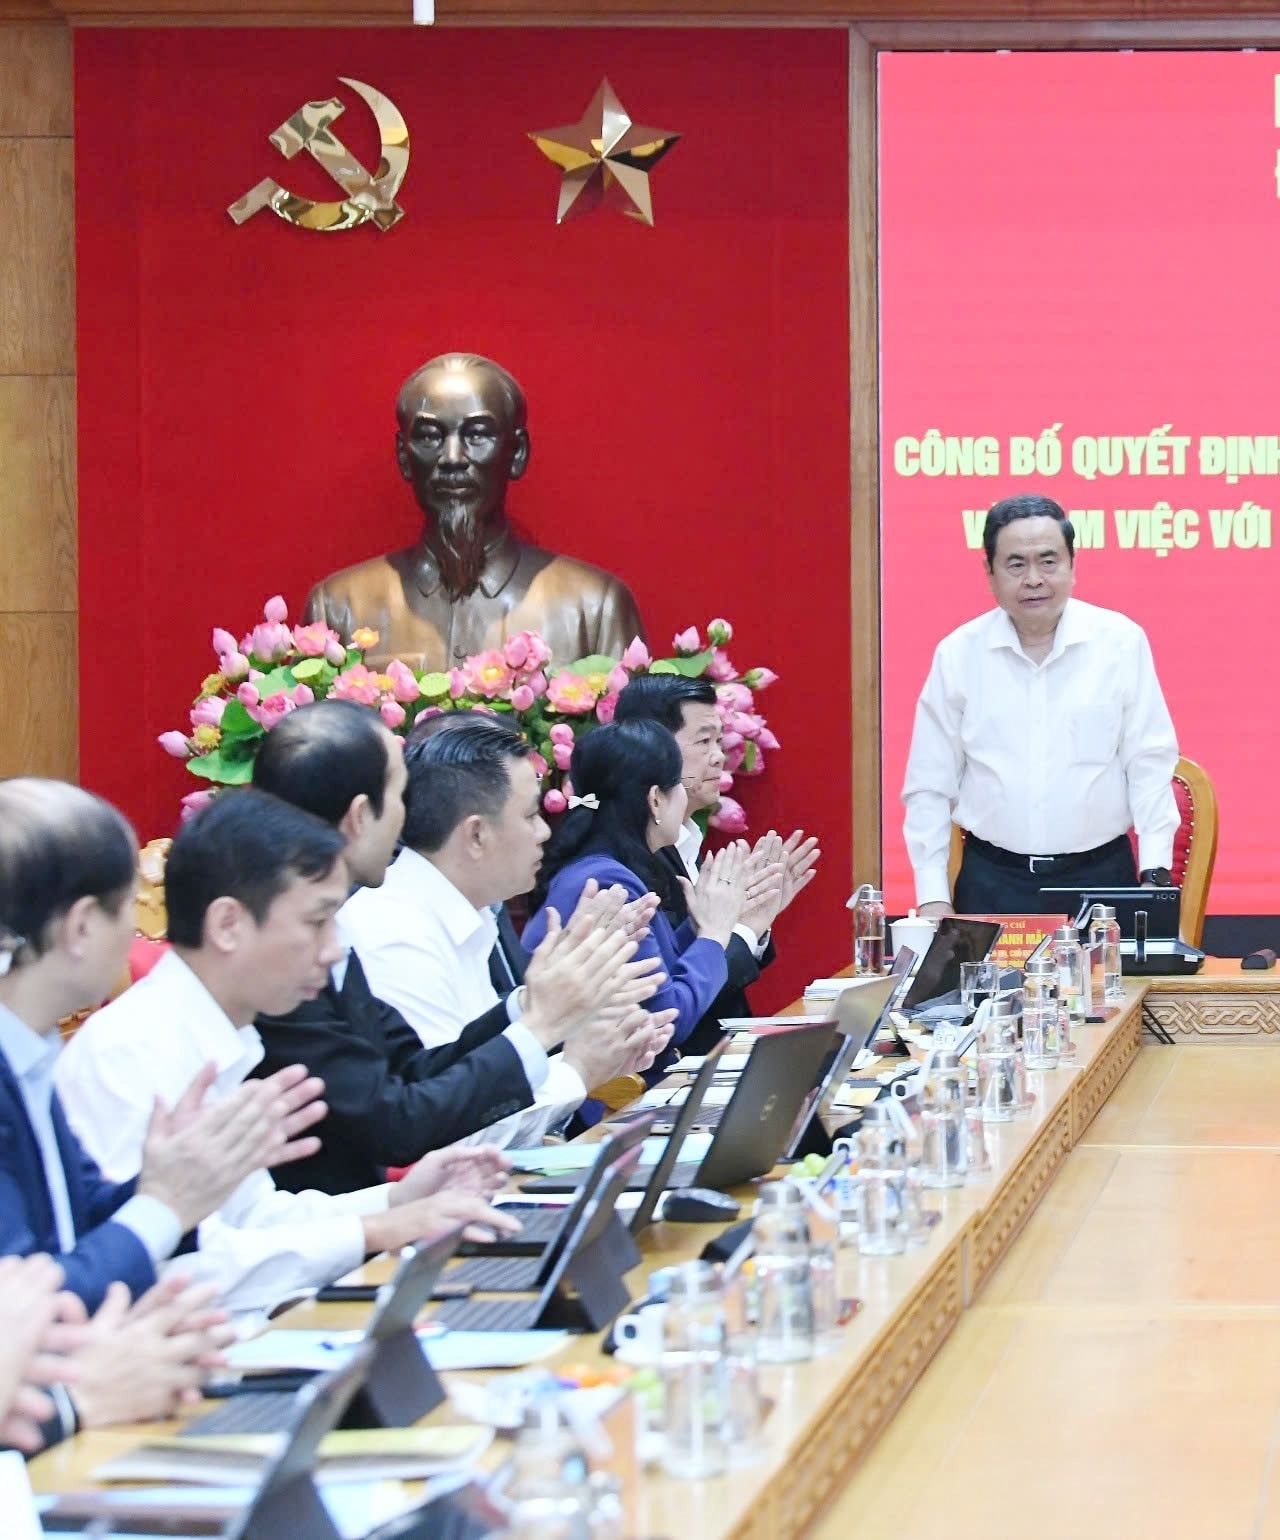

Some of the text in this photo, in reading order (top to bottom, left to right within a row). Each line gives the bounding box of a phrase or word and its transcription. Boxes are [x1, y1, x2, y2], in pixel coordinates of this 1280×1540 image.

[894, 428, 1000, 477] CÔNG
[1010, 424, 1063, 477] BỐ
[1072, 424, 1192, 480] QUYẾT
[962, 510, 989, 549] V
[1114, 502, 1200, 557] VIỆC
[1209, 501, 1272, 549] VỚI
